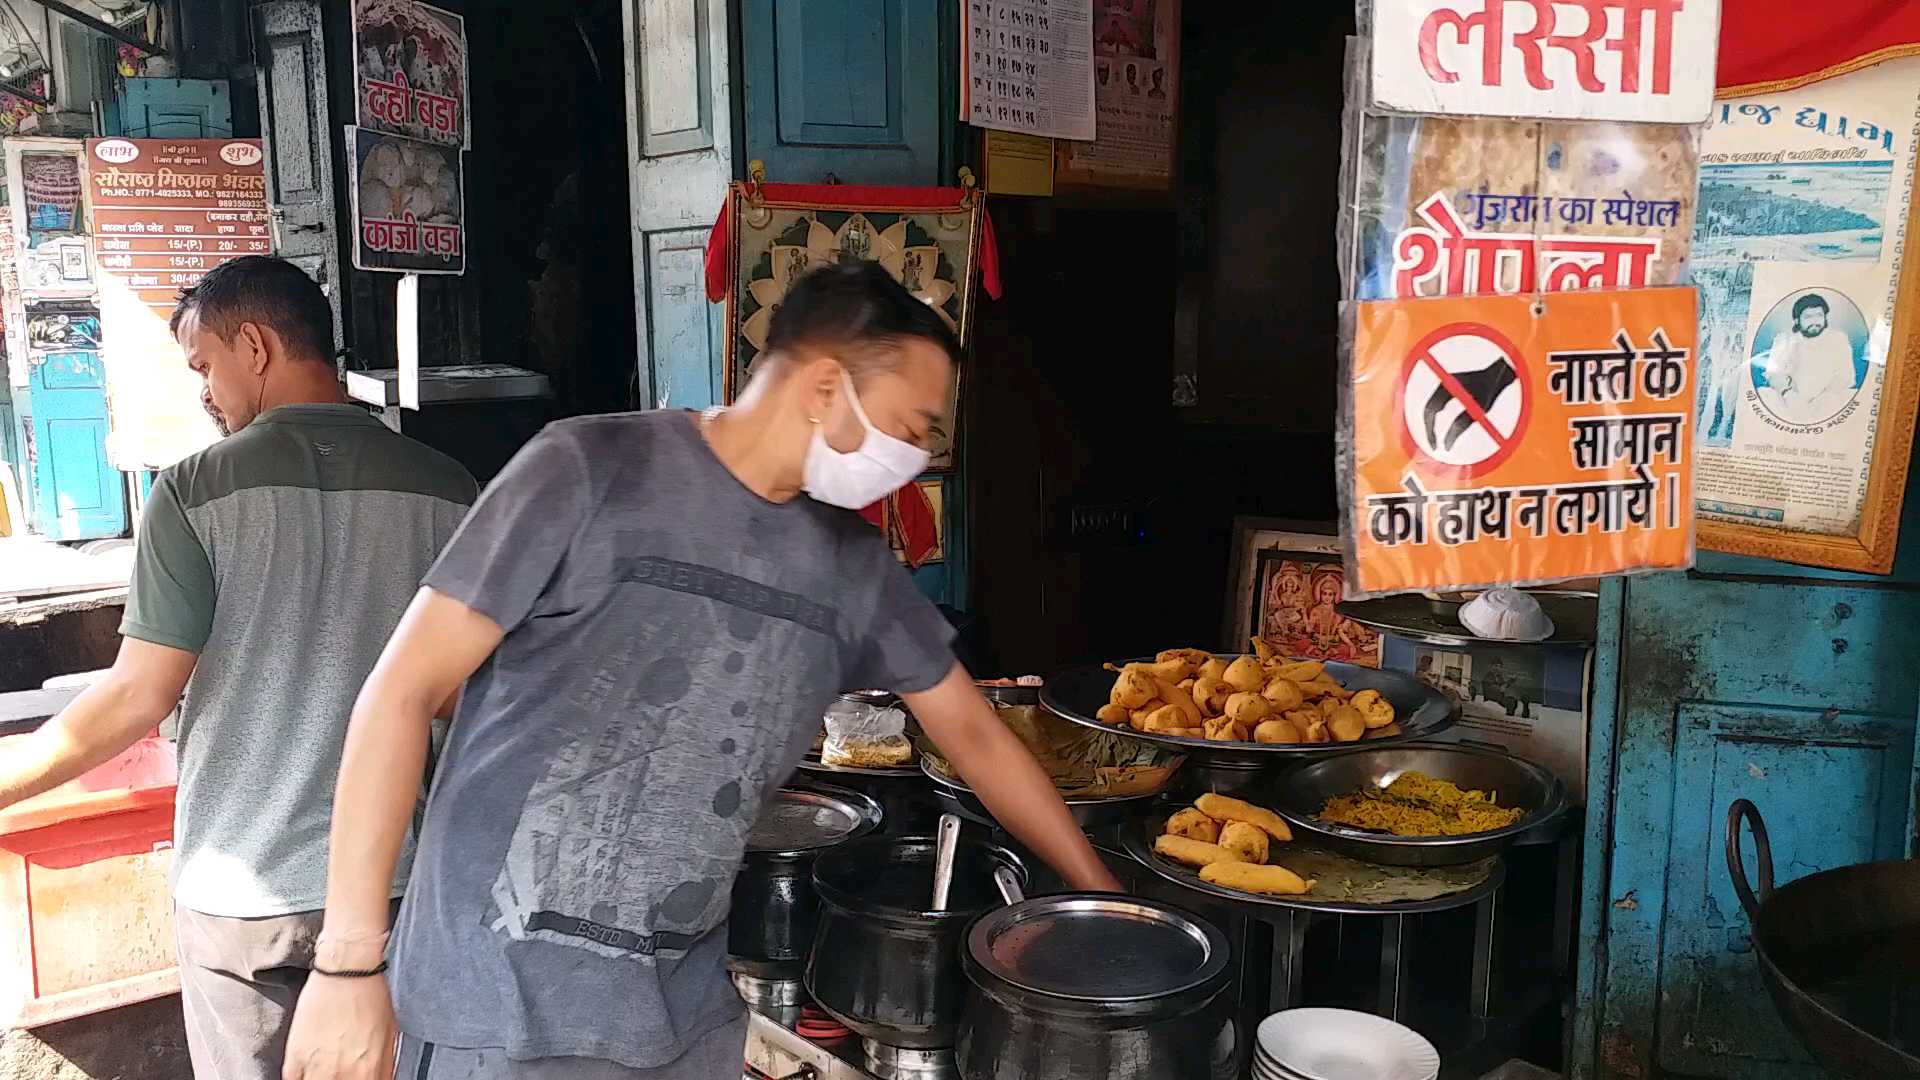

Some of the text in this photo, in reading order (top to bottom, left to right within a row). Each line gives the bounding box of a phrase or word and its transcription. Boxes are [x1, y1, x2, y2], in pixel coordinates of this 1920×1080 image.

[367, 71, 411, 124] दही
[101, 144, 133, 158] लाभ
[226, 146, 255, 161] शुभ
[222, 170, 266, 189] भंडार
[1559, 197, 1595, 224] का
[1602, 190, 1681, 227] स्पेशल
[218, 241, 237, 250] 20/-
[249, 241, 268, 250] 35/-
[364, 211, 418, 250] कांजी
[1549, 331, 1686, 402] नास्ते के
[1571, 415, 1683, 468] सामान
[1367, 475, 1427, 545] को
[1436, 488, 1511, 543] हाथ
[1519, 489, 1547, 536] न
[576, 922, 622, 945] ESTD
